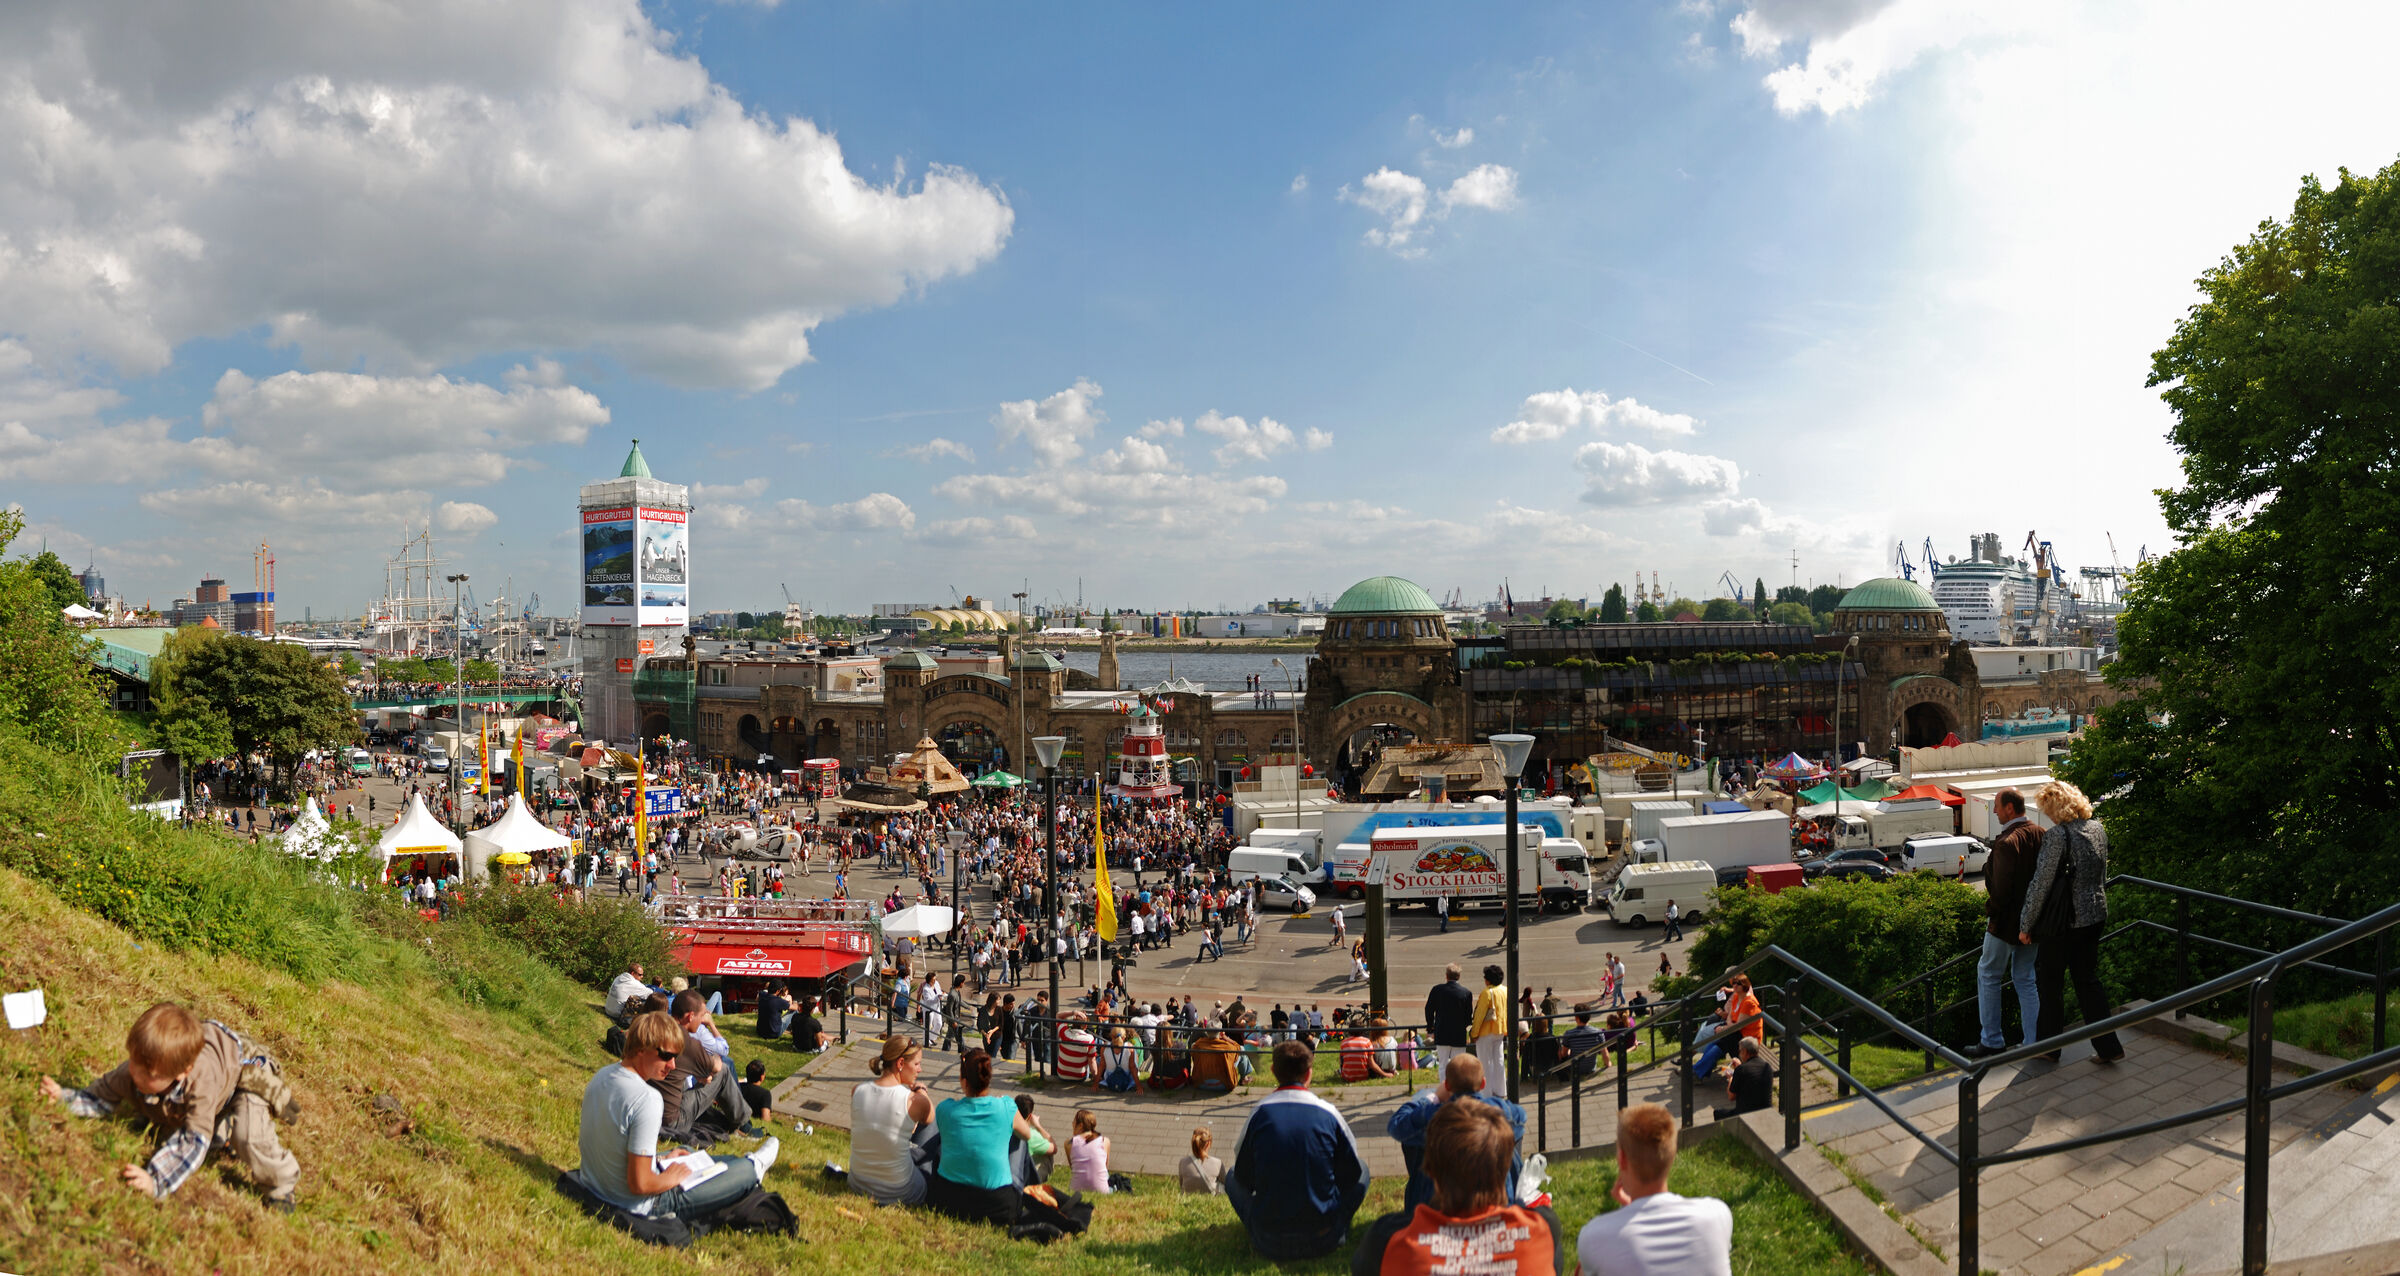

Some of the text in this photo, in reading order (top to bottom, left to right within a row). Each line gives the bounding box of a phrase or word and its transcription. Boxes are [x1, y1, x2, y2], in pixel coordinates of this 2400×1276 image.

[586, 511, 631, 521] HURTIGRUTEN
[641, 509, 685, 521] HURTIGRUTEN
[586, 573, 631, 582] FLEETENKIEKER
[646, 574, 682, 582] HAGENBECK
[1374, 842, 1418, 851] Abholmarkt
[1393, 872, 1521, 891] STOCKHAUSE
[1421, 888, 1444, 896] Telefo
[723, 961, 785, 969] ASTRA
[1438, 1222, 1506, 1237] METALLICA
[1506, 1226, 1530, 1241] TOOL
